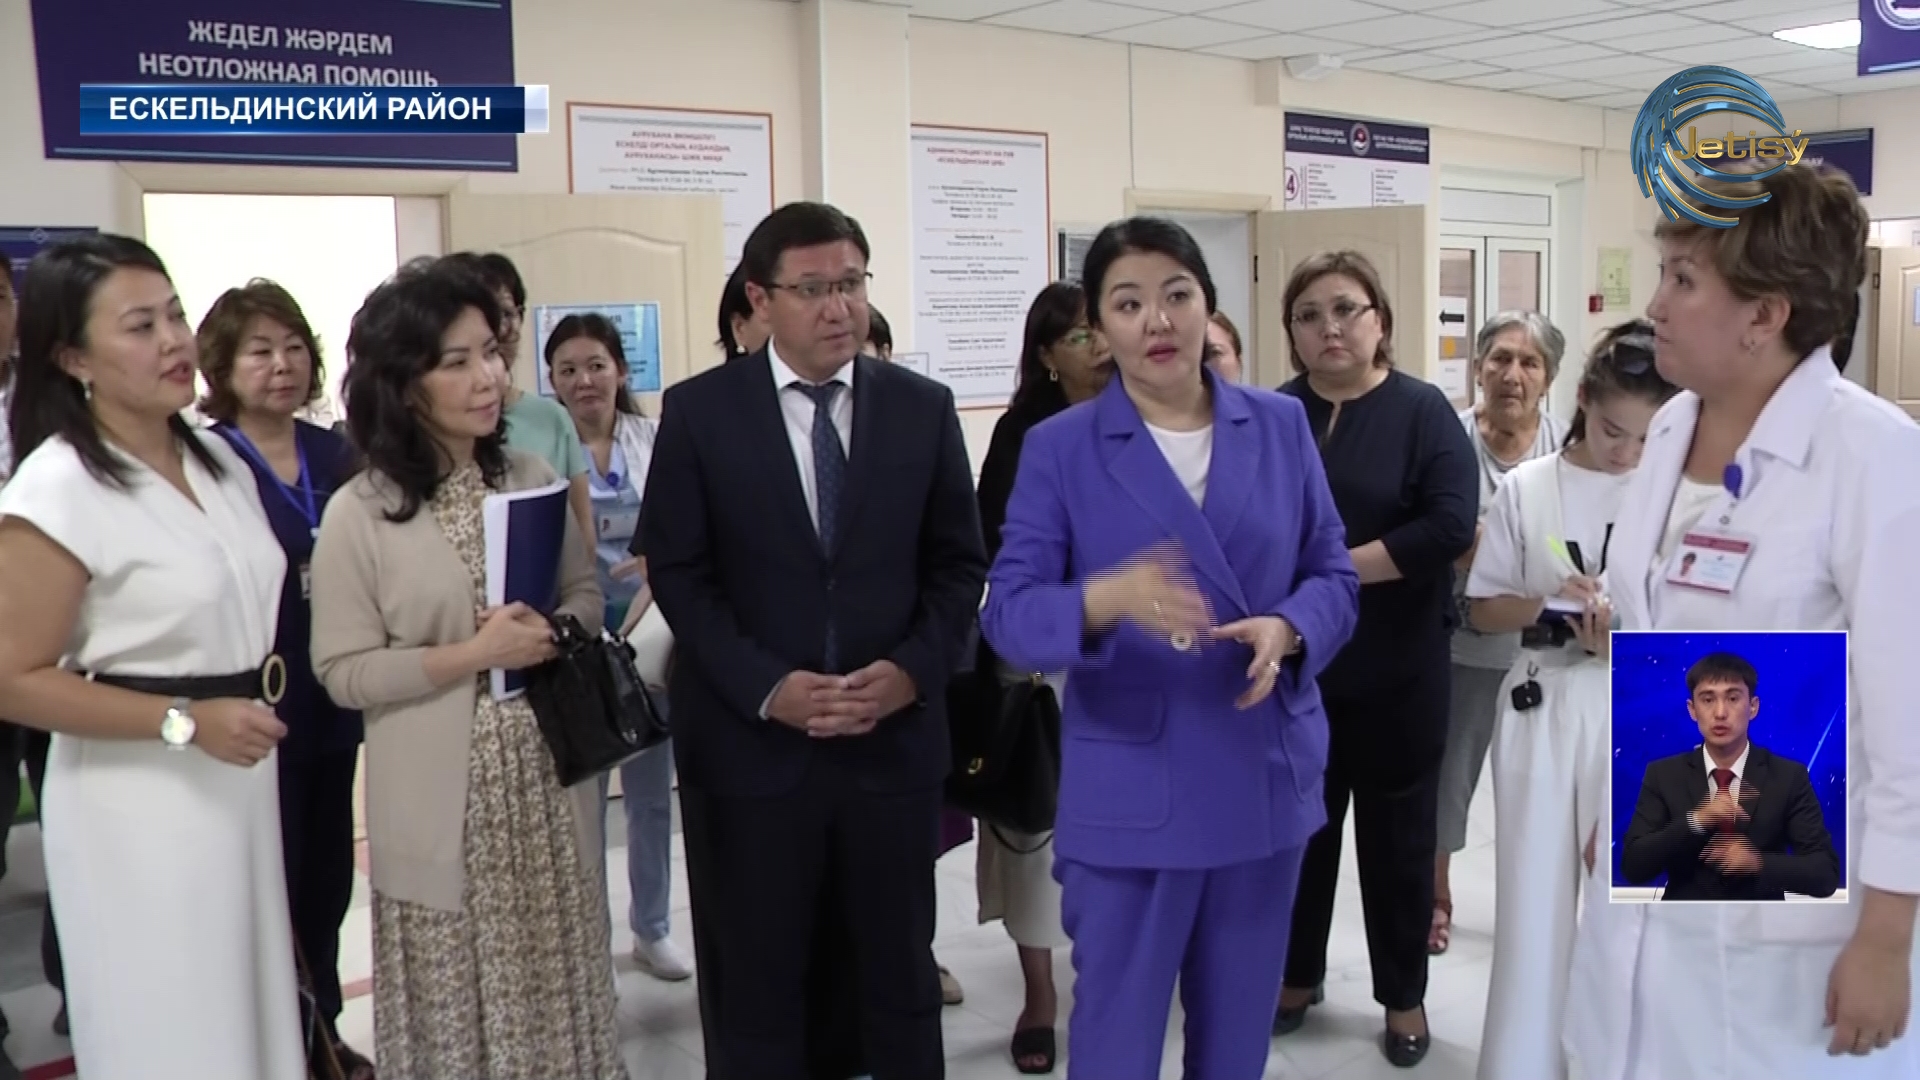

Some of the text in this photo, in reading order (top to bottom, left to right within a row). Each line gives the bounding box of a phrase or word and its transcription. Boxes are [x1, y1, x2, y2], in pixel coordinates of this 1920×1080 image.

[188, 20, 393, 57] ЖЕДЕЛ ЖӘРДЕМ
[139, 52, 317, 84] НЕОТЛОЖНАЯ
[1287, 174, 1295, 194] 4
